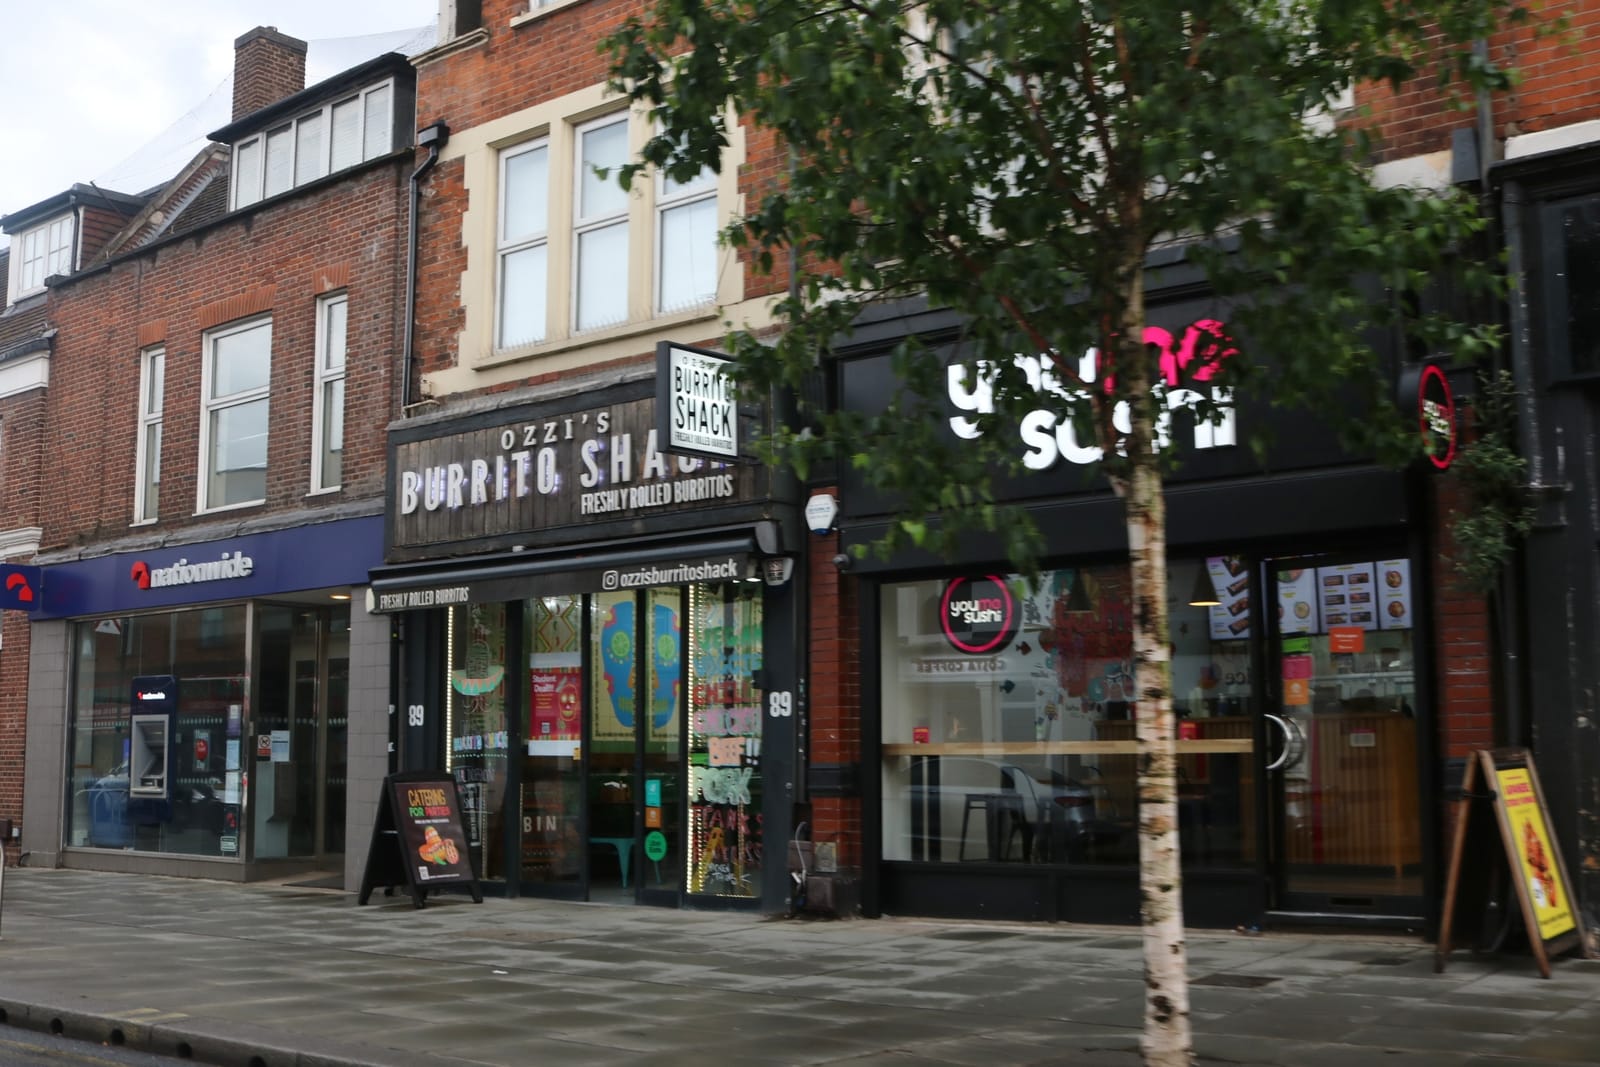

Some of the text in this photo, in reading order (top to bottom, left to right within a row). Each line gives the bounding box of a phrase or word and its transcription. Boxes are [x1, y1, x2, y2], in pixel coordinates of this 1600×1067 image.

[675, 395, 732, 438] SHACK
[501, 411, 610, 449] OZZI'S
[401, 429, 735, 514] BURRITO SHA
[581, 474, 734, 514] FRESHLY ROLLED BURRITOS
[151, 551, 253, 588] nationwide
[620, 558, 737, 587] ozzisburritoshack
[380, 586, 470, 609] FRESHLY ROLLED BURRITOS
[950, 598, 1002, 617] youme
[963, 609, 1002, 624] sushi
[408, 704, 425, 727] 89
[769, 691, 792, 718] 89
[407, 789, 447, 807] CATERING
[408, 807, 425, 817] FOR
[523, 815, 557, 833] BIN
